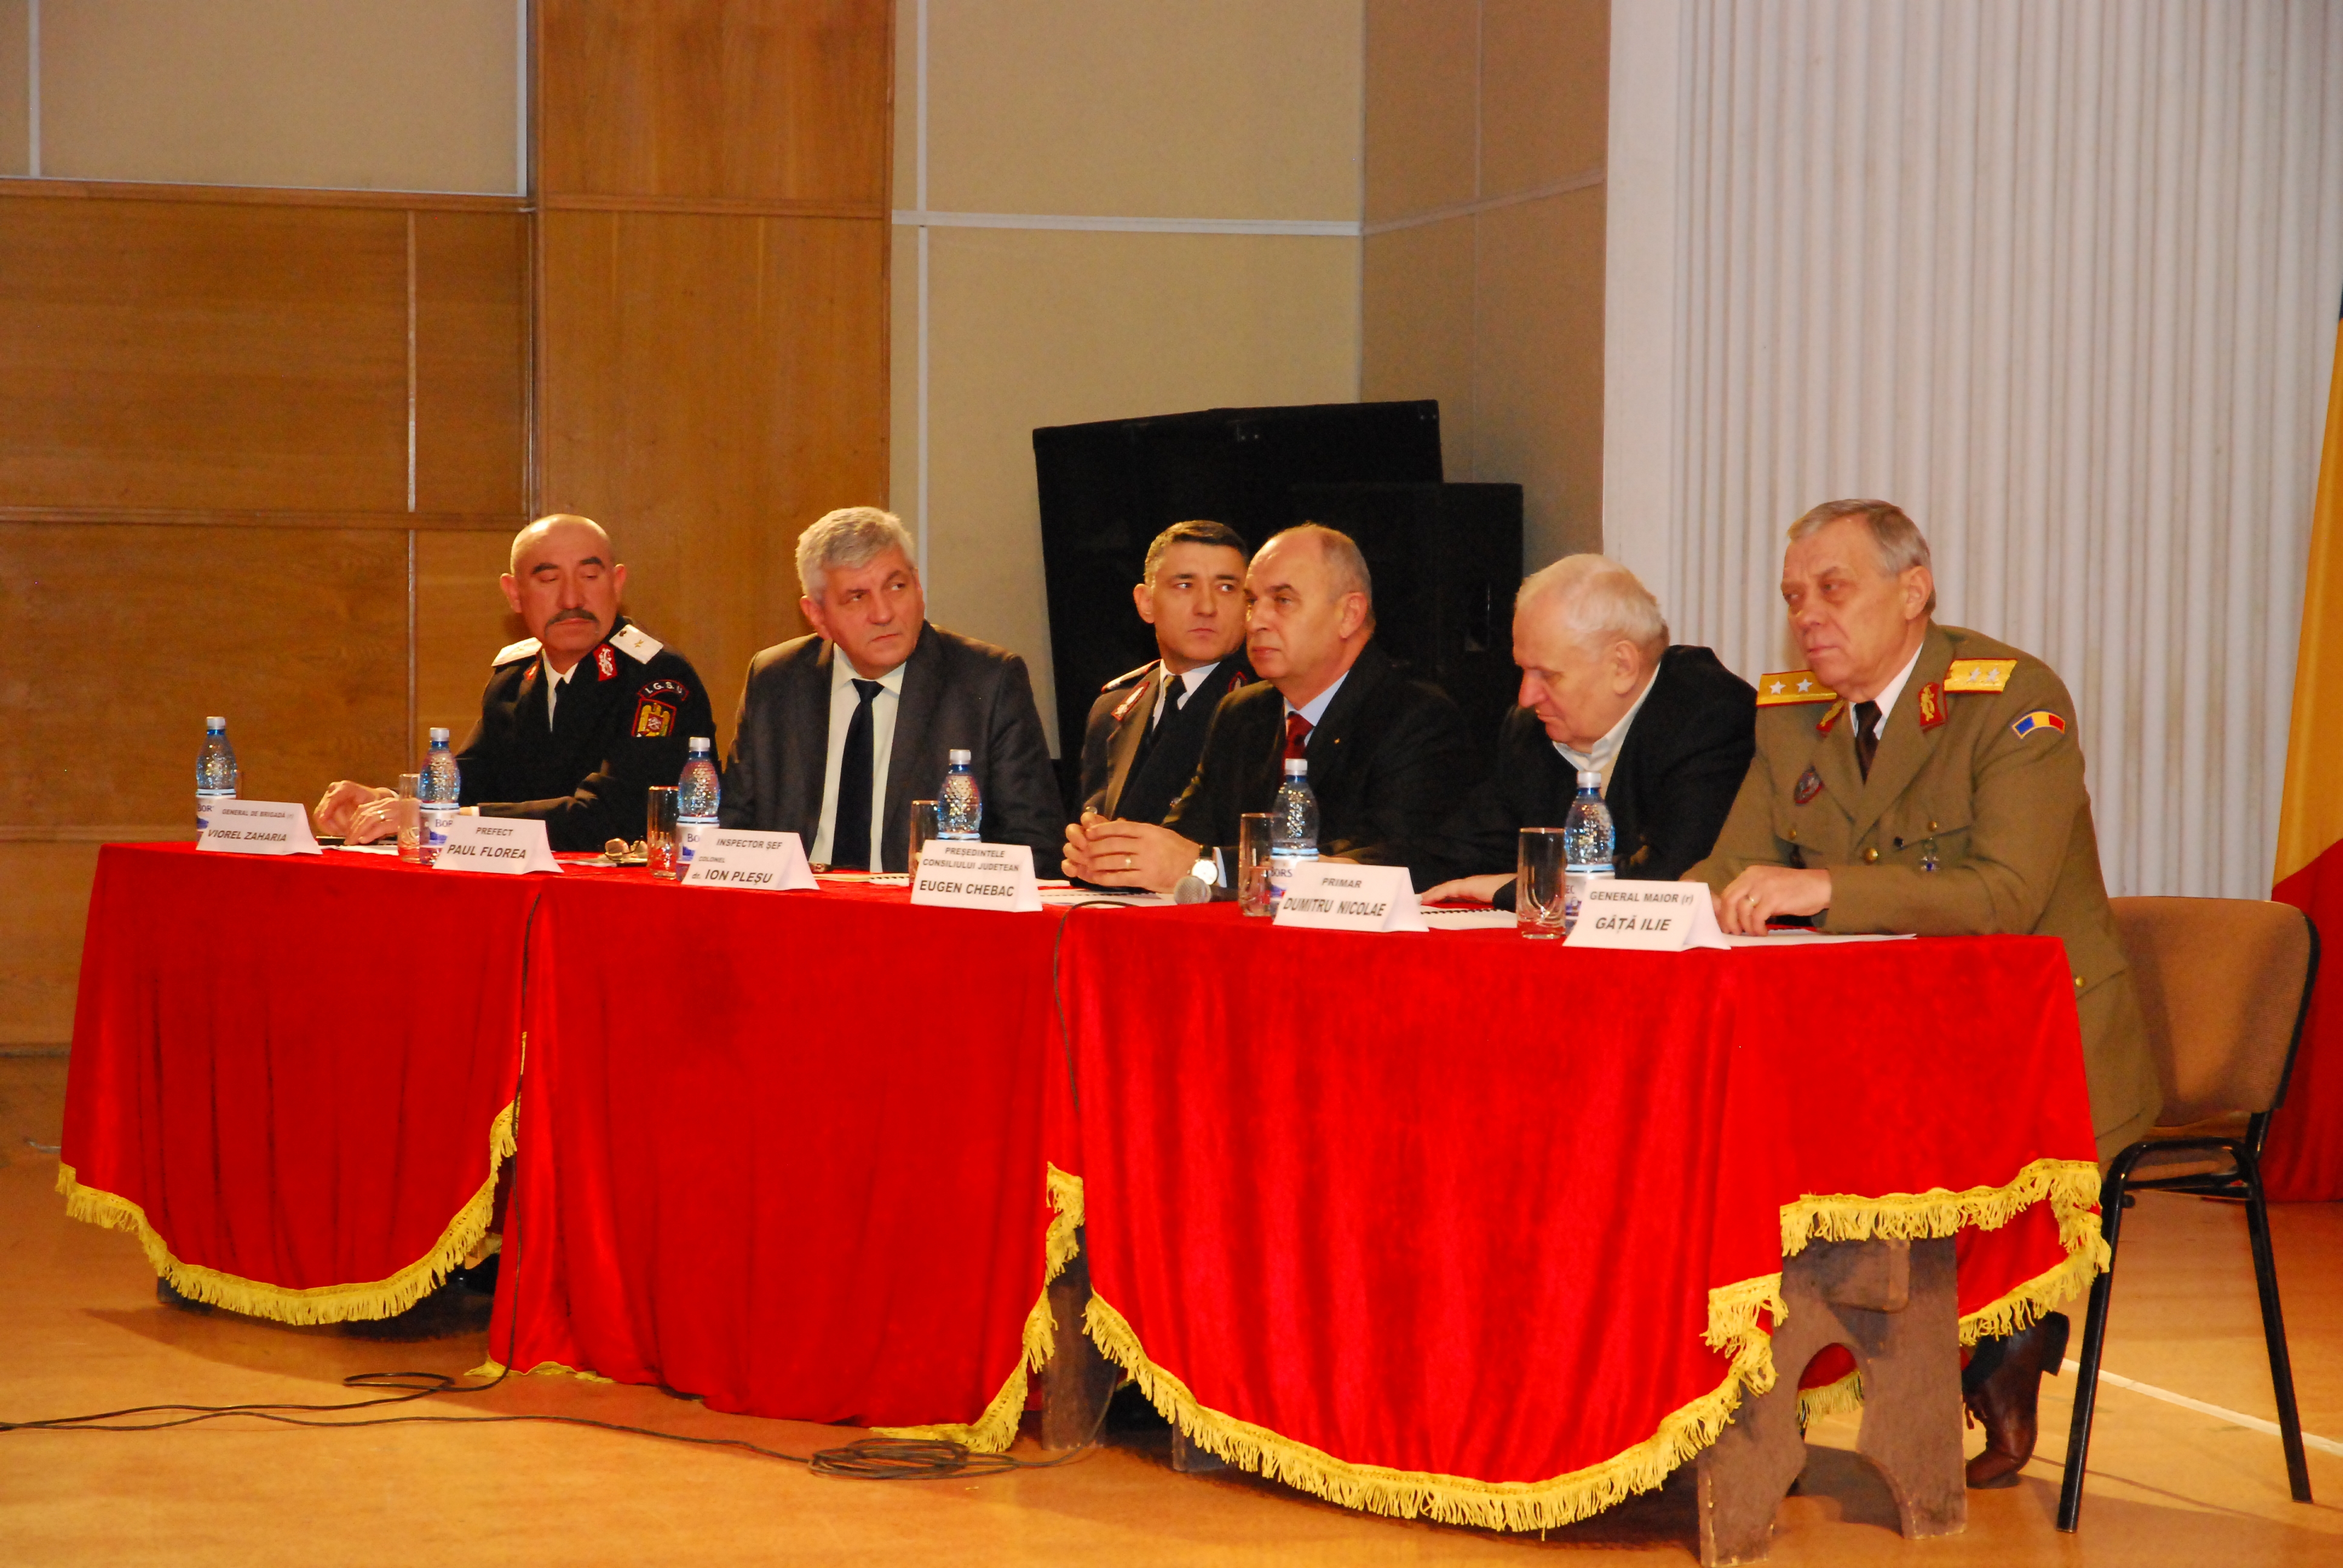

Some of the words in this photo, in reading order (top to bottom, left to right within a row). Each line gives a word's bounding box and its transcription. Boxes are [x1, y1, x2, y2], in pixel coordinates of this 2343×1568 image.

[208, 829, 241, 839] VIOREL
[244, 832, 287, 841] ZAHARIA
[476, 827, 513, 836] PREFECT
[716, 838, 764, 849] INSPECTOR
[447, 844, 476, 855] PAUL
[480, 847, 526, 858] FLOREA
[923, 858, 976, 869] CONSILIULUI
[705, 869, 729, 881] ION
[920, 880, 962, 893] EUGEN
[966, 884, 1015, 897] CHEBAC
[1322, 878, 1362, 888] PRIMAR
[1590, 891, 1640, 902] GENERAL
[1643, 893, 1679, 903] MAIOR
[1681, 894, 1694, 905] (r)
[1283, 898, 1334, 913] DUMITRU
[1337, 901, 1386, 916] NICOLAE
[1640, 918, 1671, 931] ILIE
